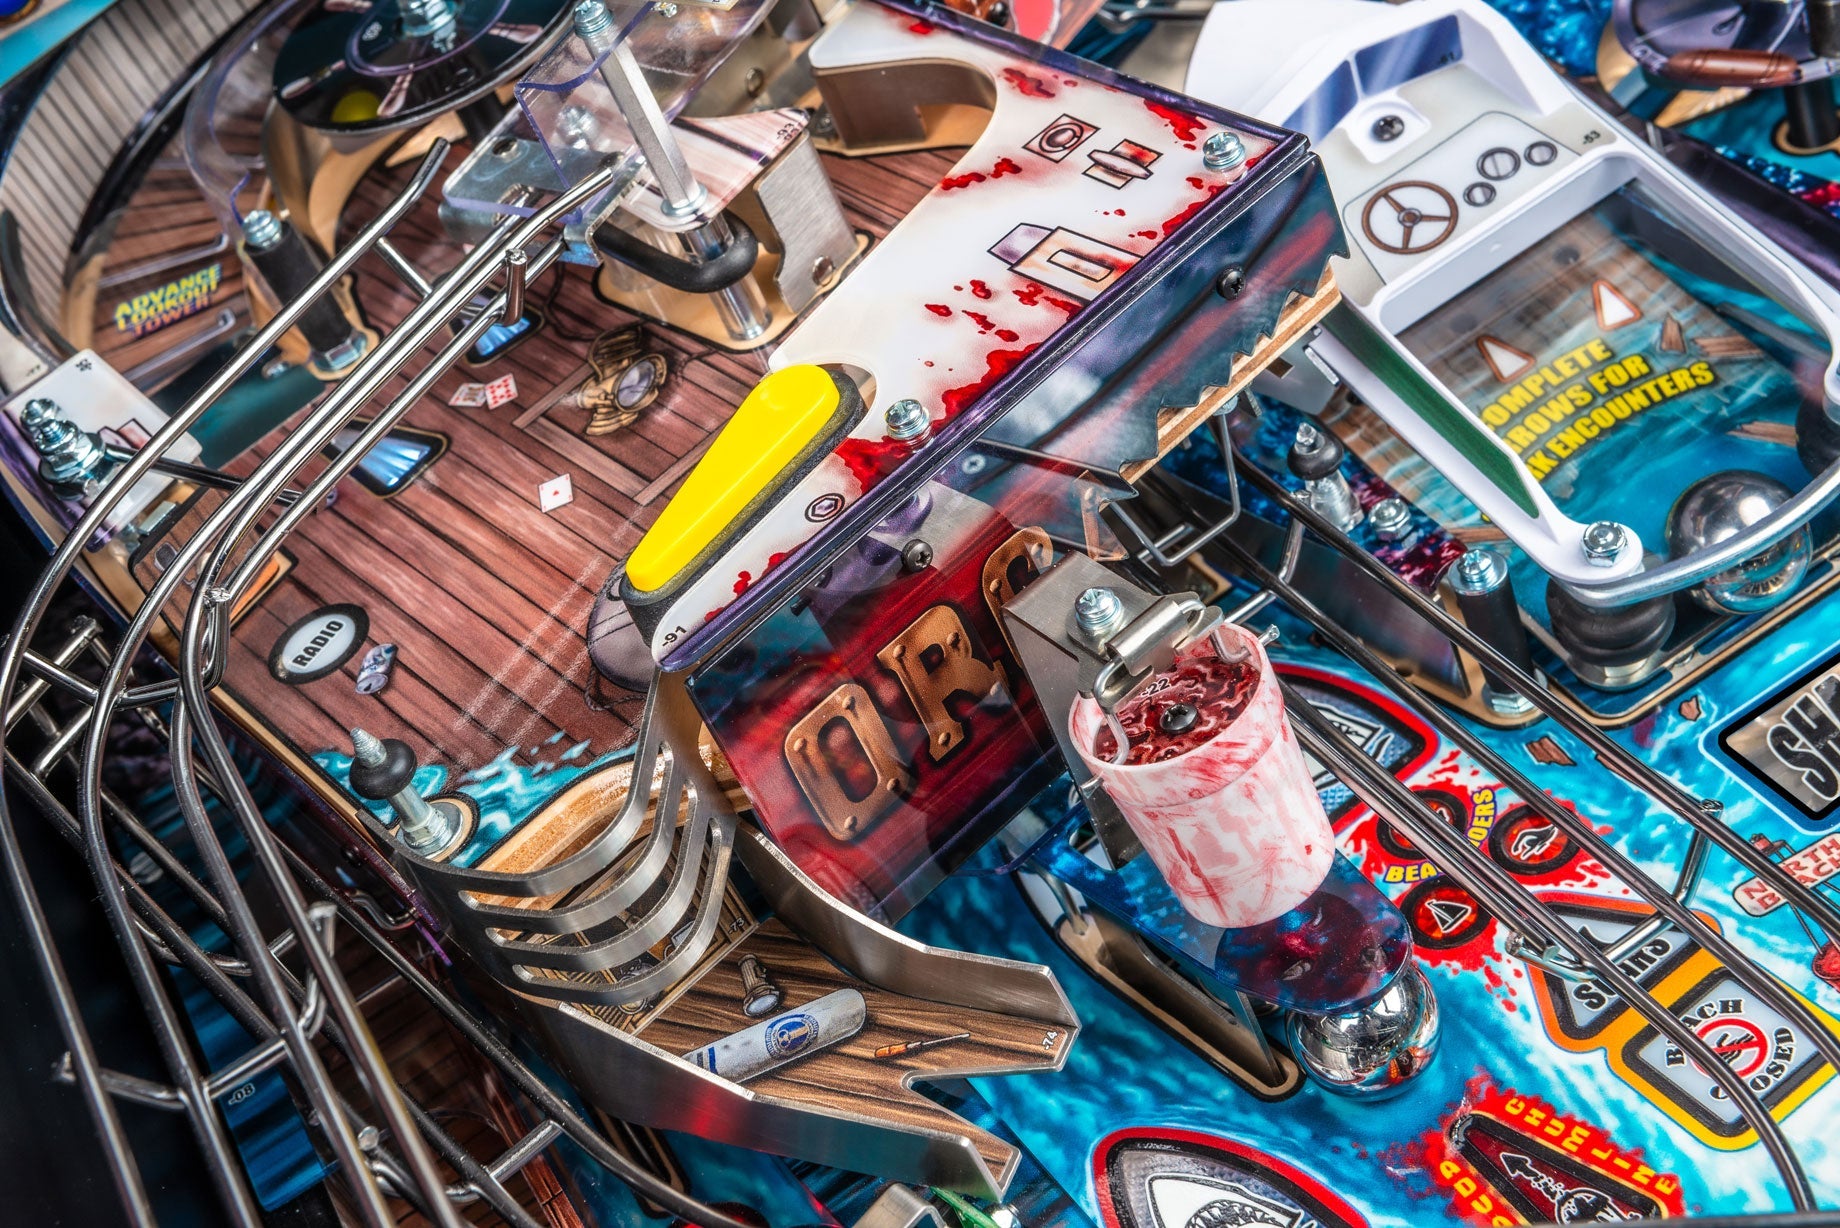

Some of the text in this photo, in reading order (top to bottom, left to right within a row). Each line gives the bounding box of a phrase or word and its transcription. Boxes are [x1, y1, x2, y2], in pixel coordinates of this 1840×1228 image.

[115, 263, 221, 319] ADVANCE
[117, 278, 217, 331] LOOKOUT
[133, 294, 210, 336] TOWER
[1482, 338, 1612, 431] OMPLETE
[1587, 354, 1650, 395] FOR
[1546, 361, 1715, 459] ENCOUNTERS
[292, 621, 344, 667] RADIO
[662, 626, 687, 646] -91
[1142, 678, 1171, 696] -22
[1742, 838, 1840, 900] NRTH
[1042, 1031, 1058, 1050] -74
[1665, 999, 1744, 1067] BACH
[1710, 1027, 1795, 1101] COSED
